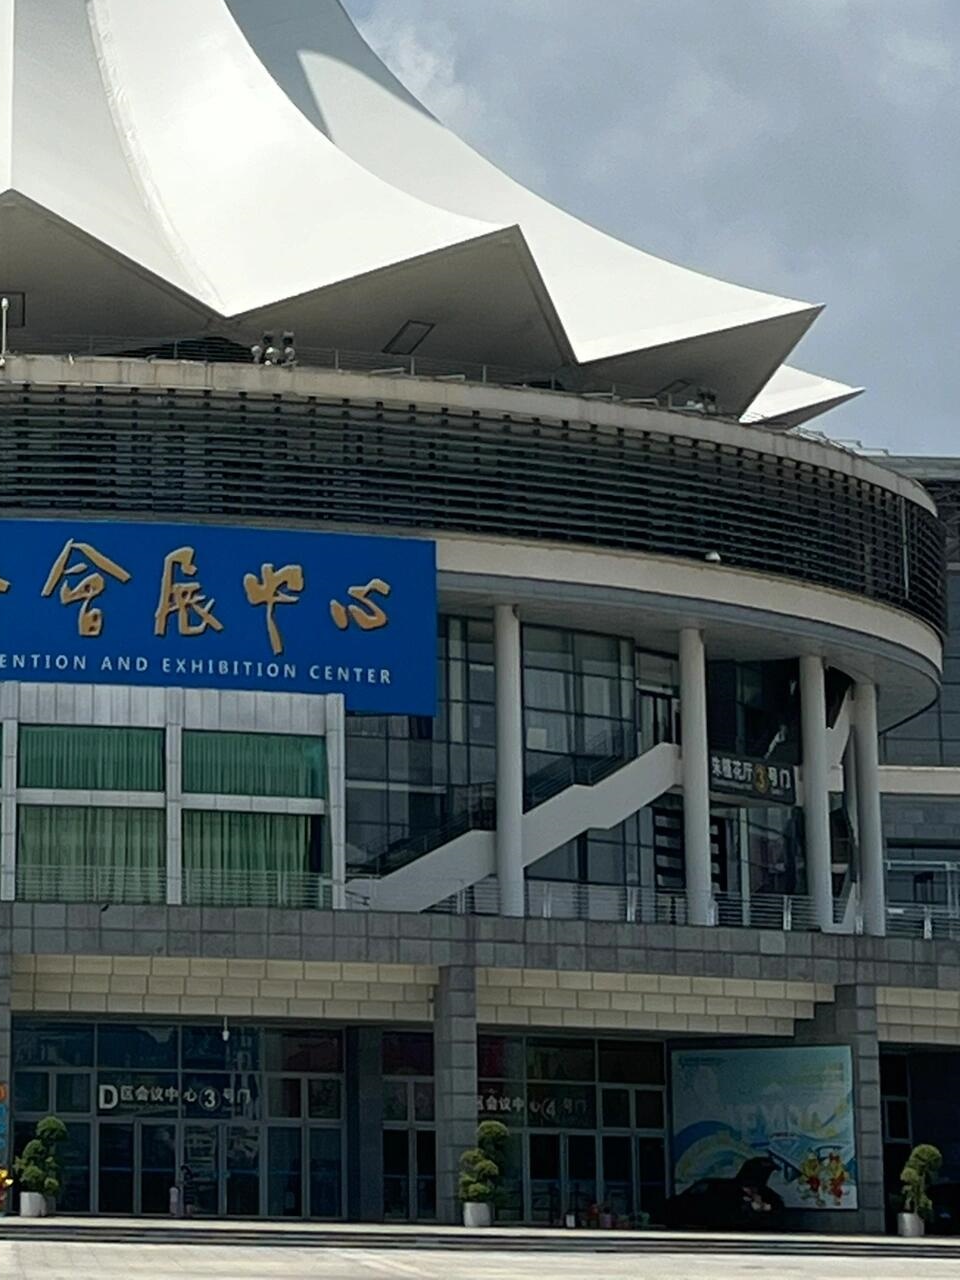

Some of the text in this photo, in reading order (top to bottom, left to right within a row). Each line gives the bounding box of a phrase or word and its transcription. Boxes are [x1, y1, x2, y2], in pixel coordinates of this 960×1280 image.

[101, 656, 148, 672] AND
[162, 657, 296, 679] EXHIBITION
[310, 661, 392, 685] CENTER
